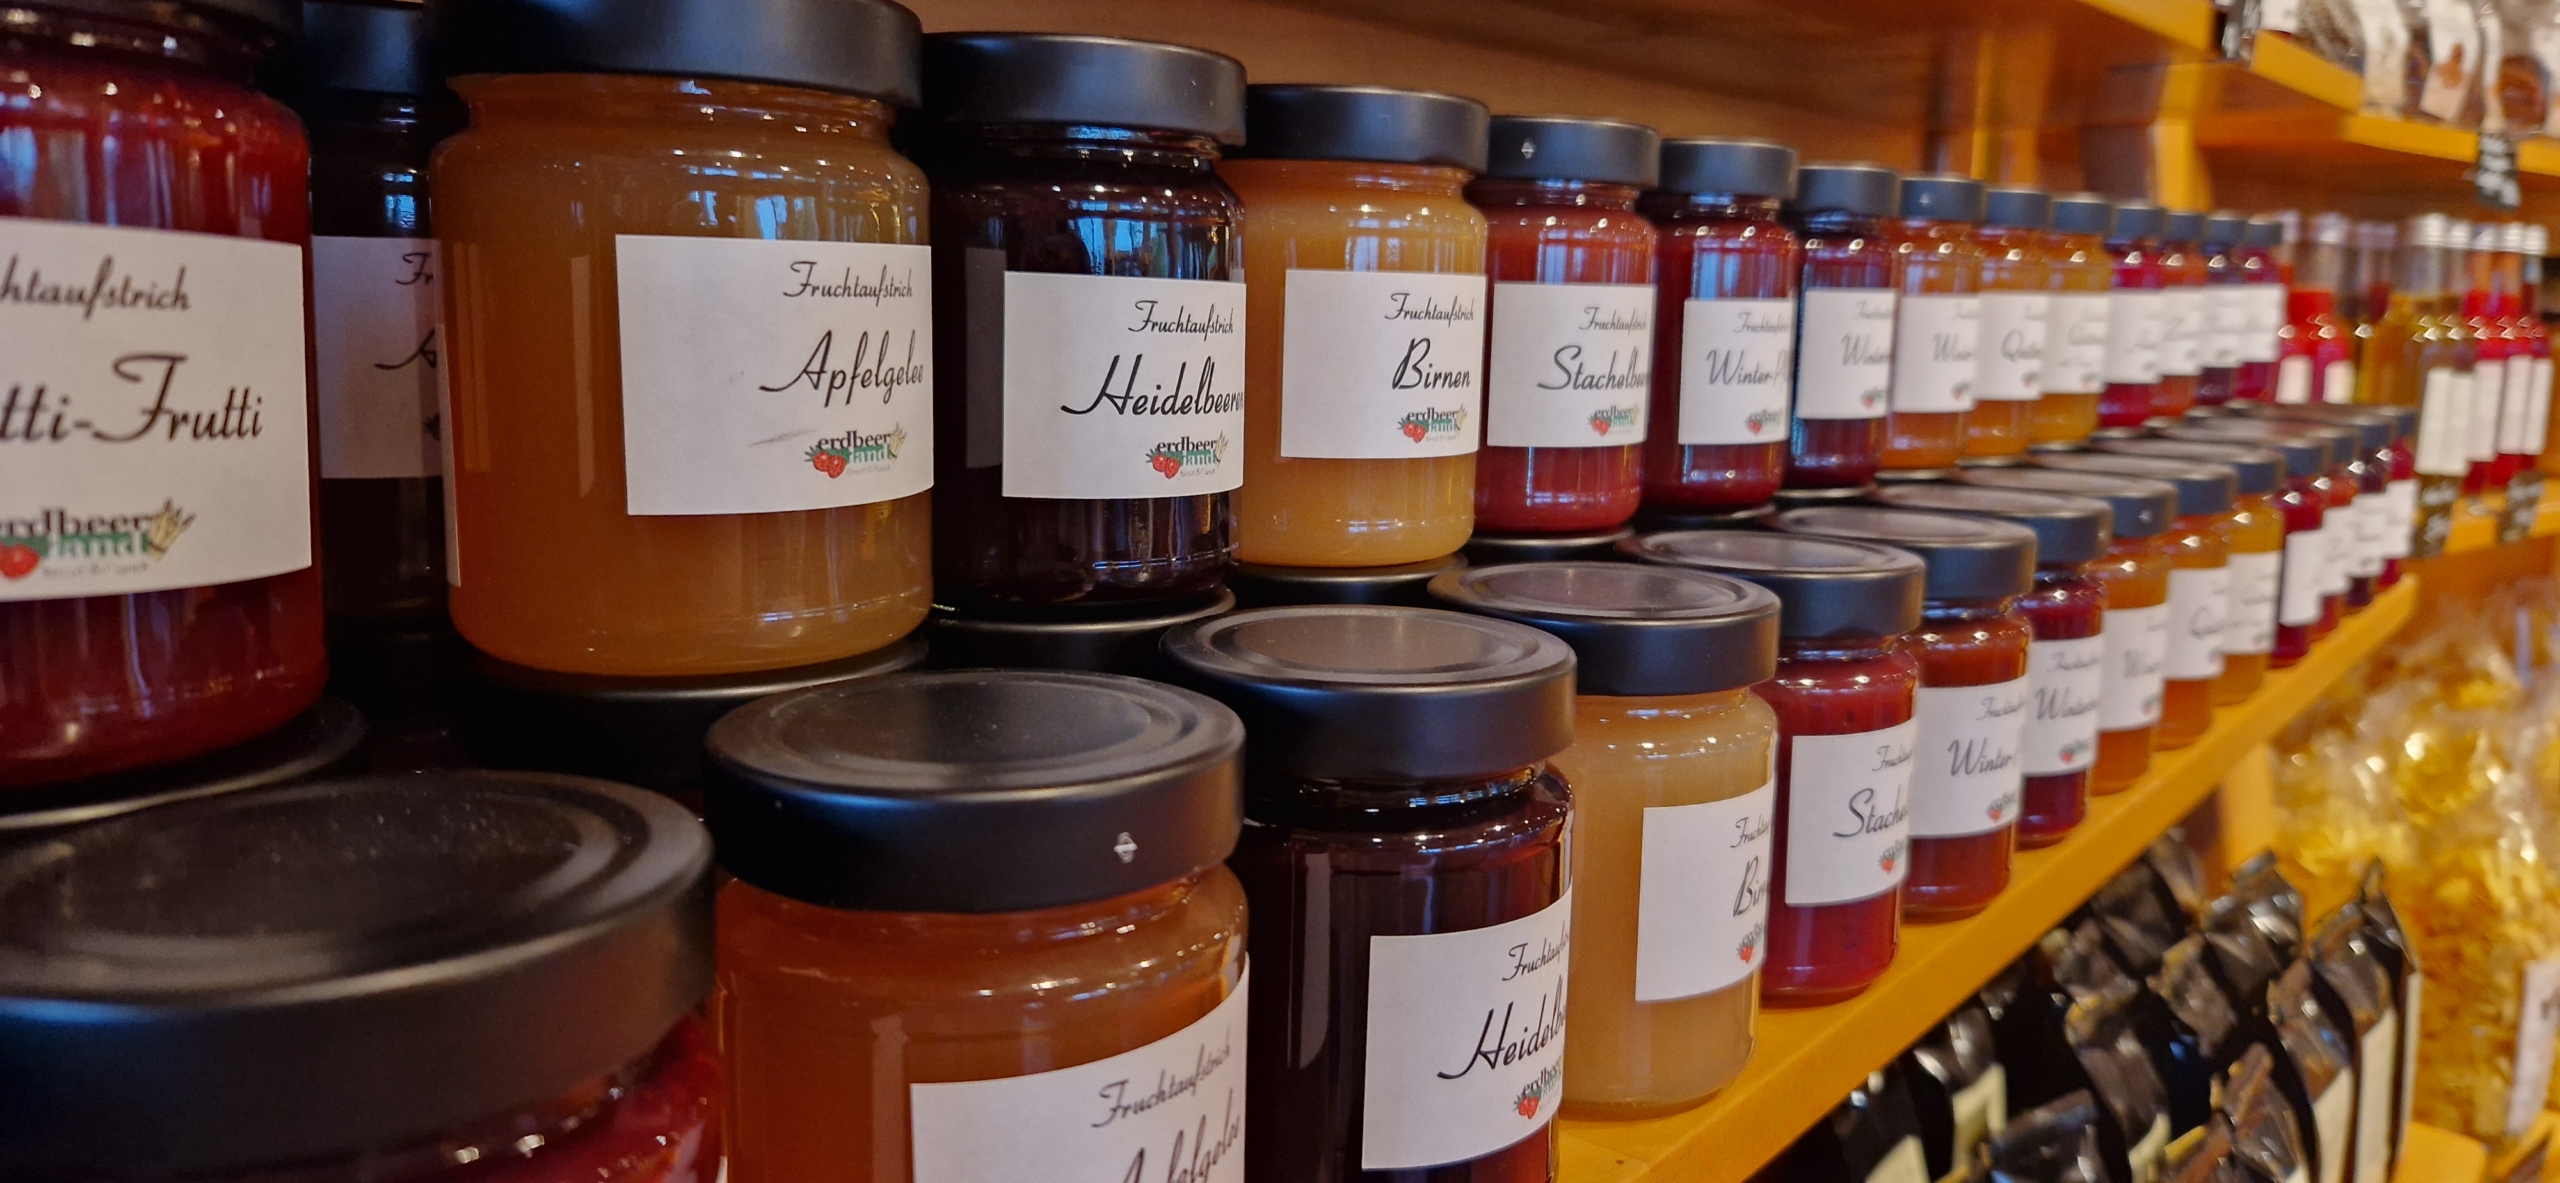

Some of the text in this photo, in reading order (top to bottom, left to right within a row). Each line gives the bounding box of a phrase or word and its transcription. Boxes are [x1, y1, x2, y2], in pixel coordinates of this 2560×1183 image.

[783, 260, 913, 306] Fruchtaufstrich
[1128, 300, 1234, 341] Fruchtaufstrich
[1384, 292, 1475, 328] Fruchtaufstrich
[759, 329, 924, 408] Apfelgelee
[1391, 337, 1471, 390] Birnen
[1406, 407, 1458, 421] erdbeer
[817, 430, 893, 451] erdbeer
[1156, 436, 1217, 453] erdbeer
